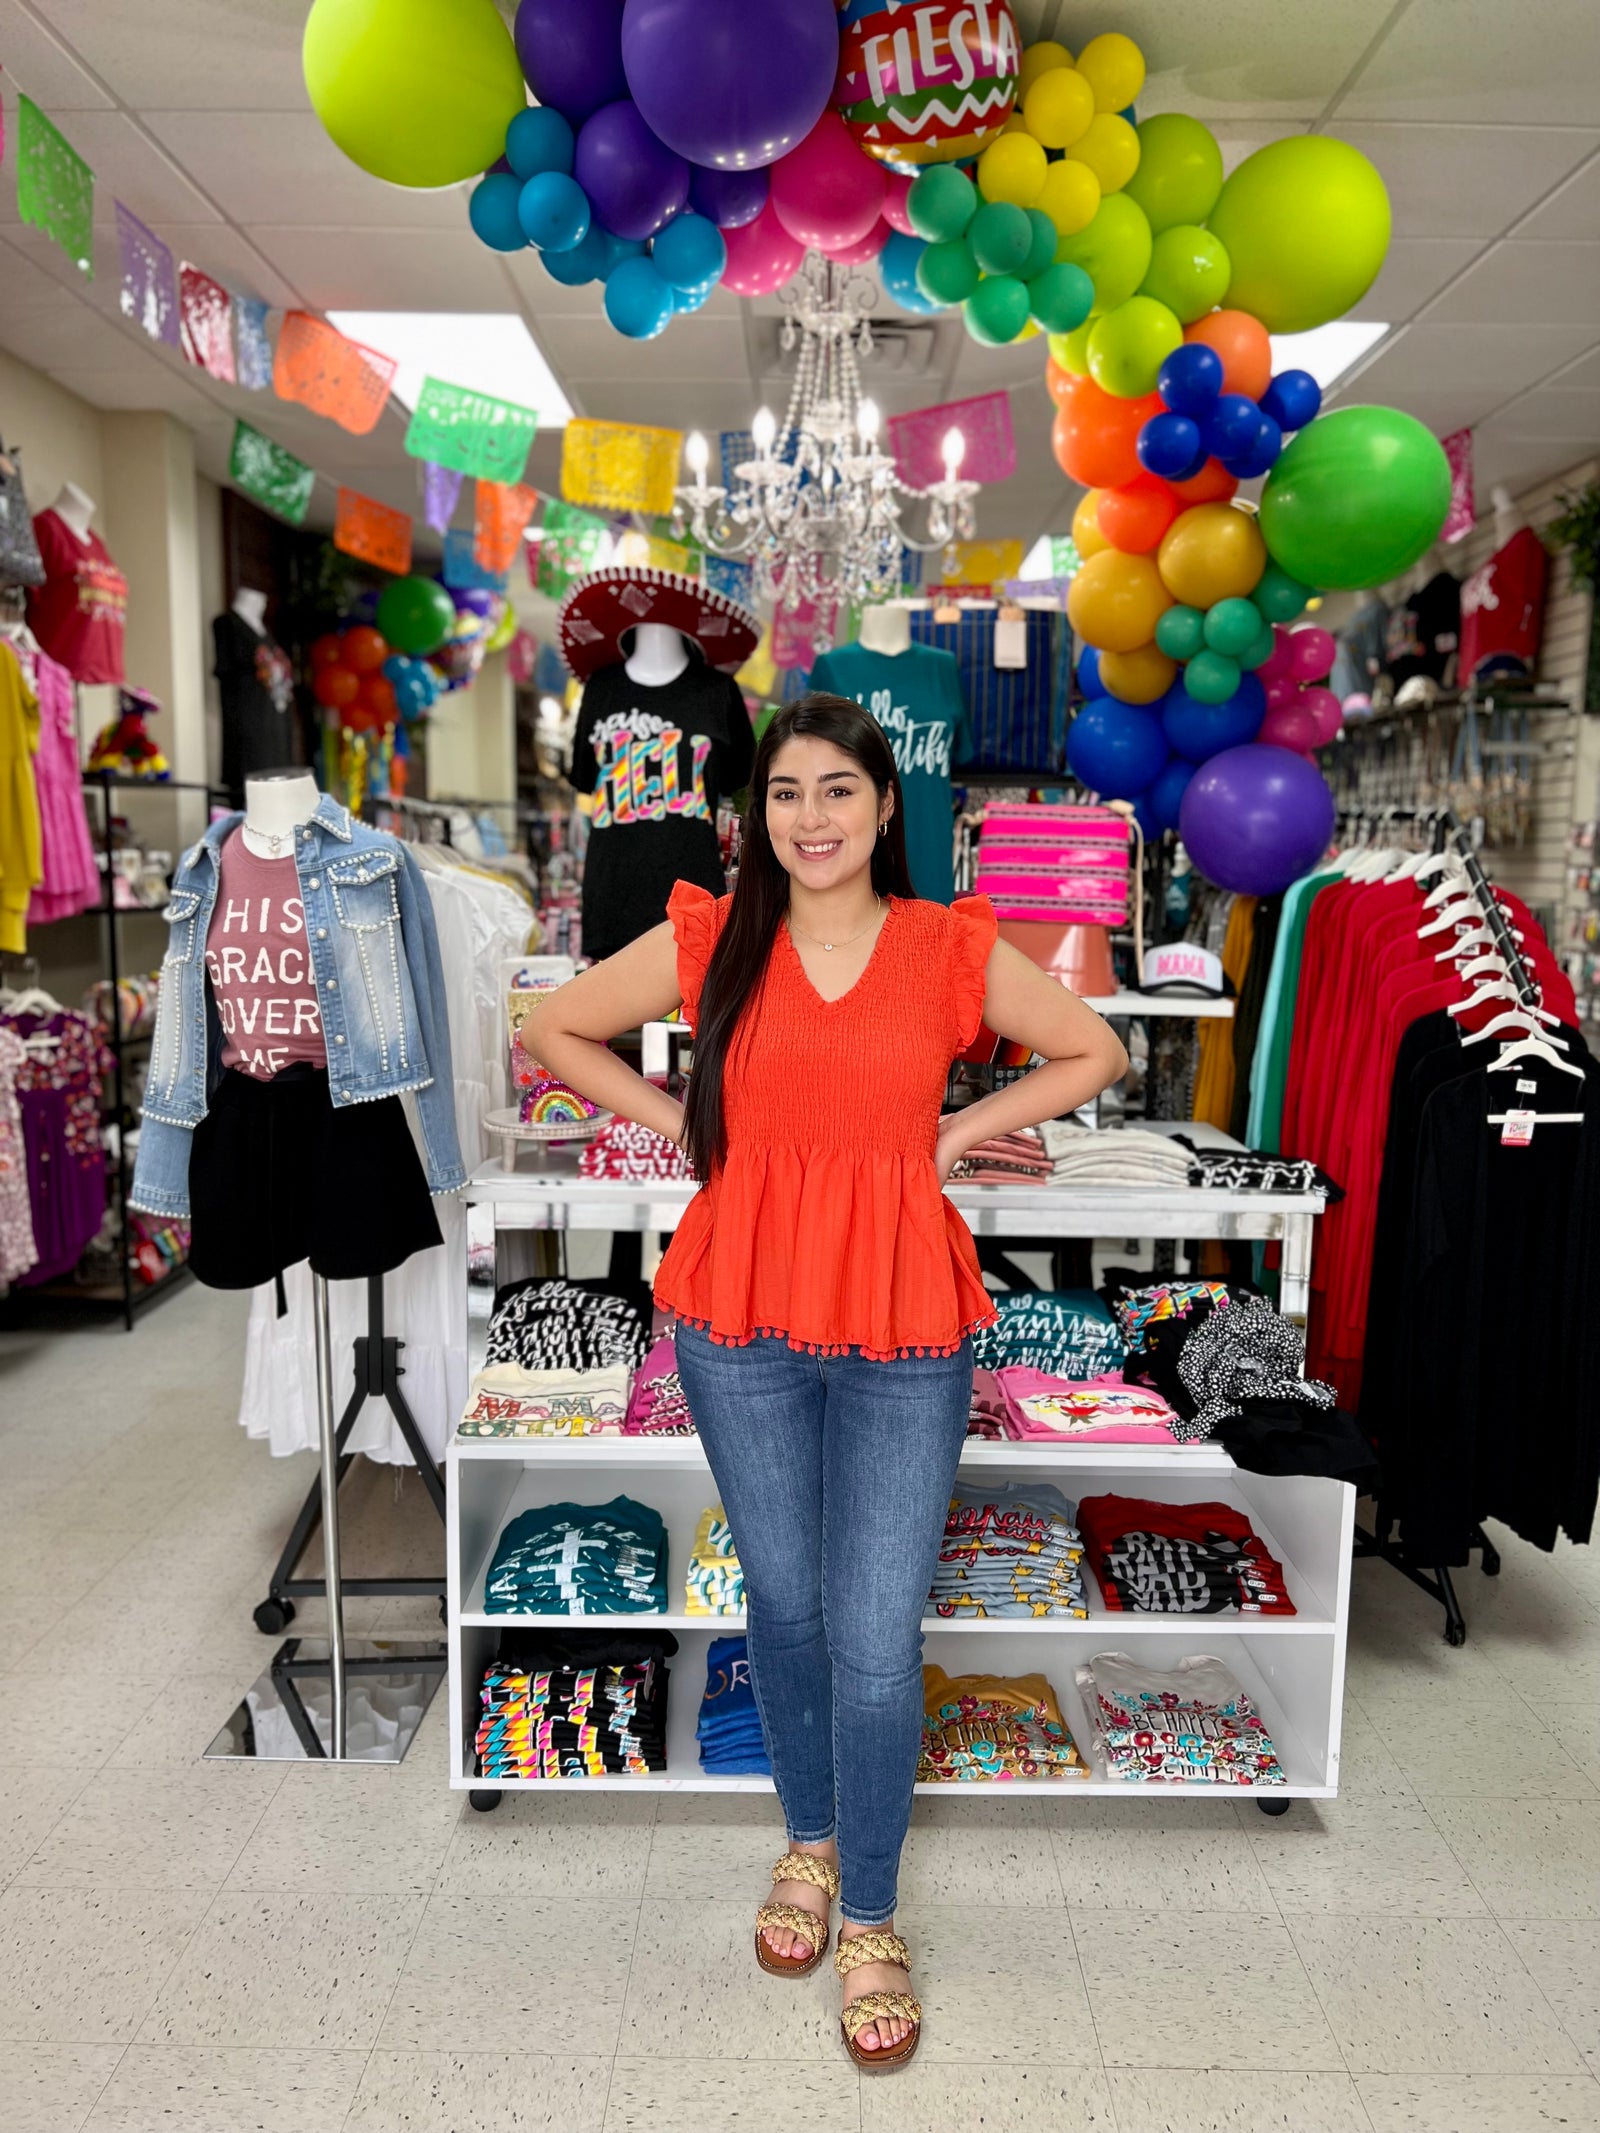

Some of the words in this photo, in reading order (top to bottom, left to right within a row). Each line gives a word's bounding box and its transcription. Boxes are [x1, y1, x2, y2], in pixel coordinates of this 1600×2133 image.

[860, 0, 1020, 108] FIESTA
[588, 707, 675, 745] raise
[222, 897, 304, 934] HIS
[1156, 953, 1207, 980] MAMA
[929, 1729, 956, 1750] BE
[957, 1721, 1014, 1745] HAPPY
[1132, 1712, 1162, 1731] BE
[1162, 1711, 1220, 1737] HAPPY
